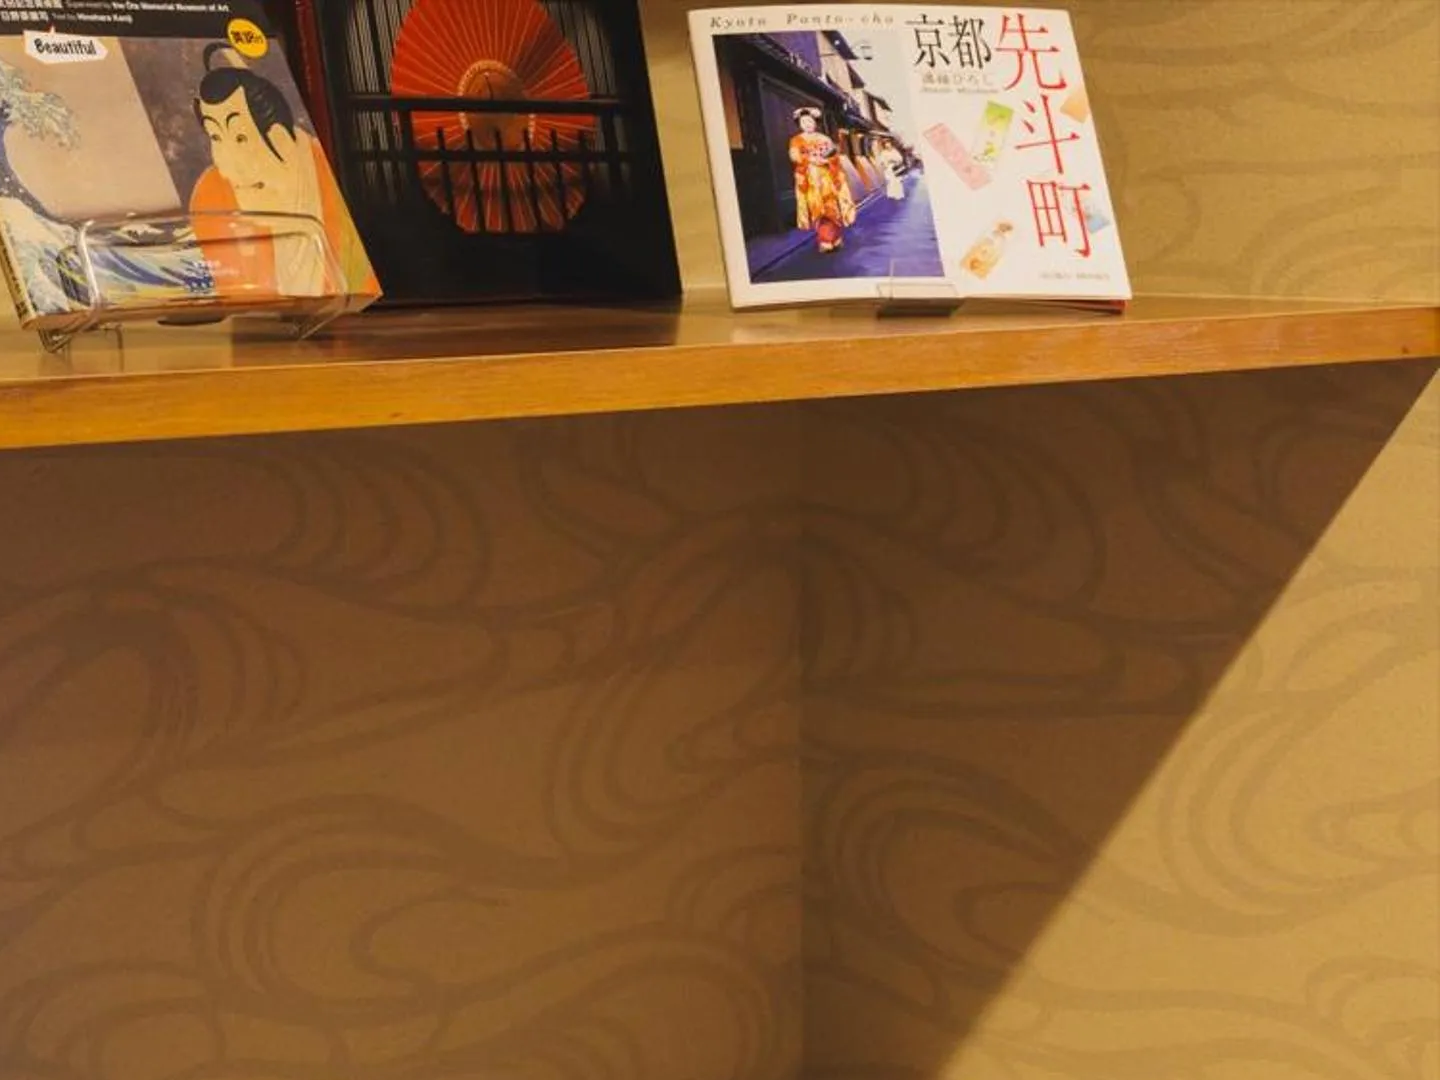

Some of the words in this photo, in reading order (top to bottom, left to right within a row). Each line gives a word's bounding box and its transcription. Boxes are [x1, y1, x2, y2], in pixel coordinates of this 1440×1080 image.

[710, 16, 767, 29] Kyoto
[904, 13, 993, 69] 京都
[33, 37, 97, 55] Beautiful
[995, 13, 1092, 257] 先斗町
